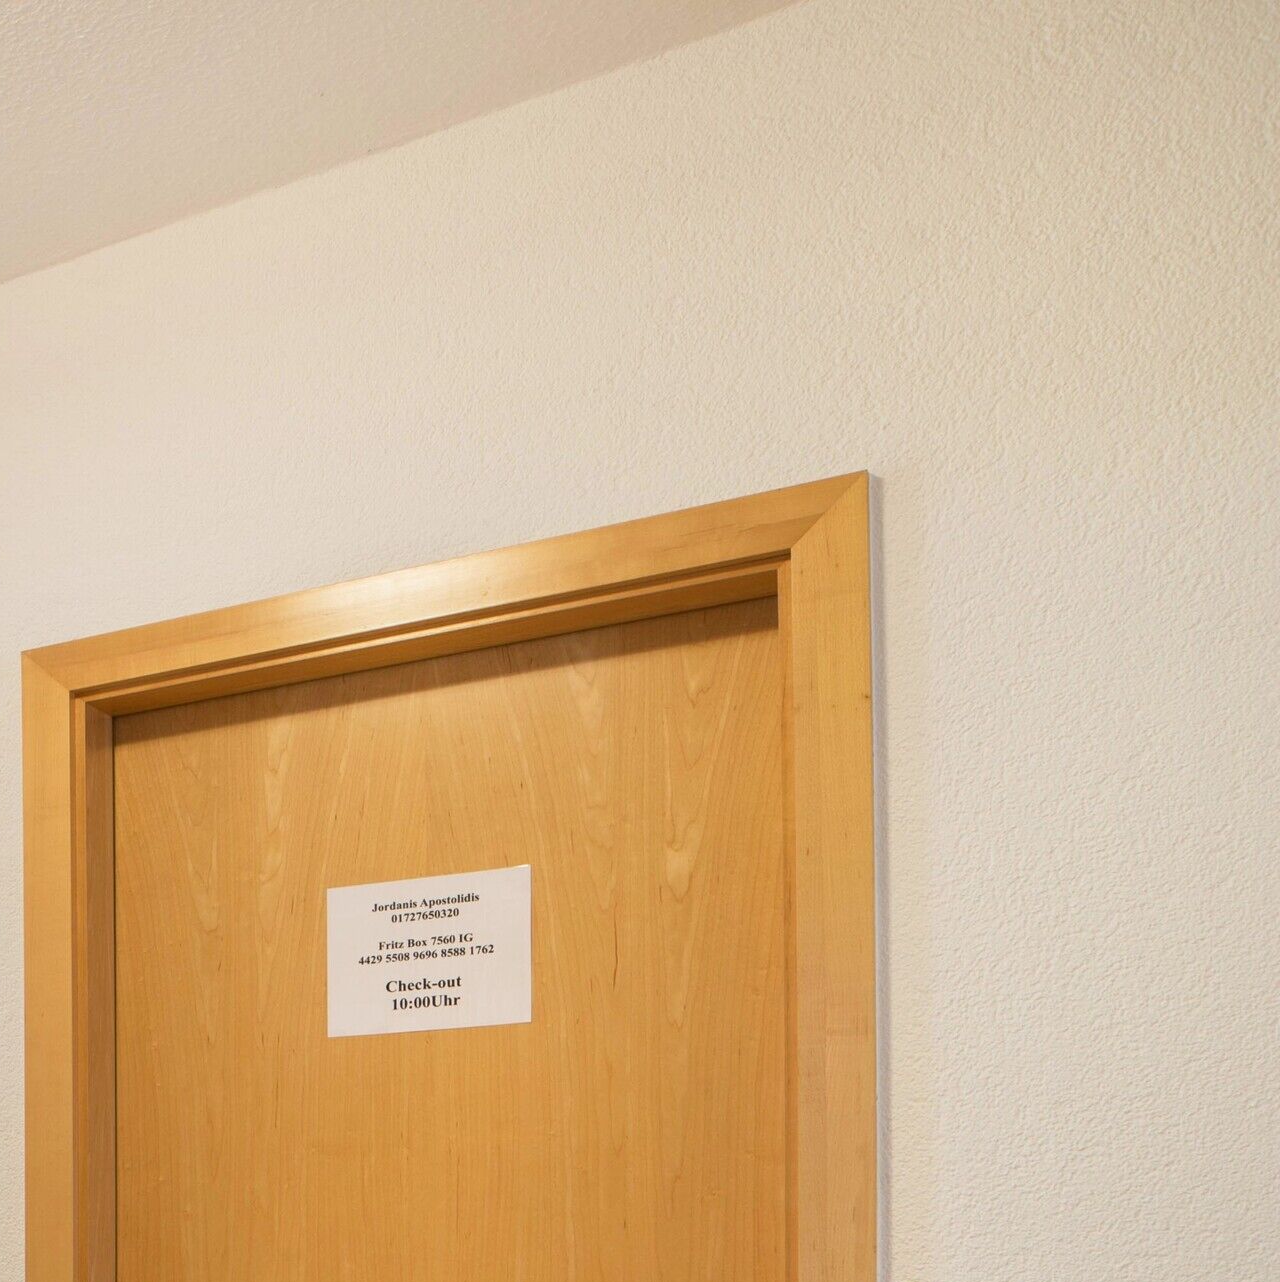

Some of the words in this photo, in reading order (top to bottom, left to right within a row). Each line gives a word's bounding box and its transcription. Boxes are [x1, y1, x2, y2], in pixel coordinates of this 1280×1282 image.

[372, 900, 417, 913] Jordanis
[420, 893, 480, 907] Apostolidis
[391, 908, 459, 923] 01727650320
[379, 941, 404, 950] Fritz
[408, 938, 427, 948] Box
[431, 935, 455, 945] 7560
[459, 933, 473, 943] IG
[359, 955, 382, 965] 4429
[385, 953, 410, 963] 5508
[413, 950, 438, 960] 9696
[441, 948, 466, 958] 8588
[470, 944, 494, 955] 1762
[386, 976, 461, 993] Check-out
[392, 995, 460, 1010] 10:00Uhr
